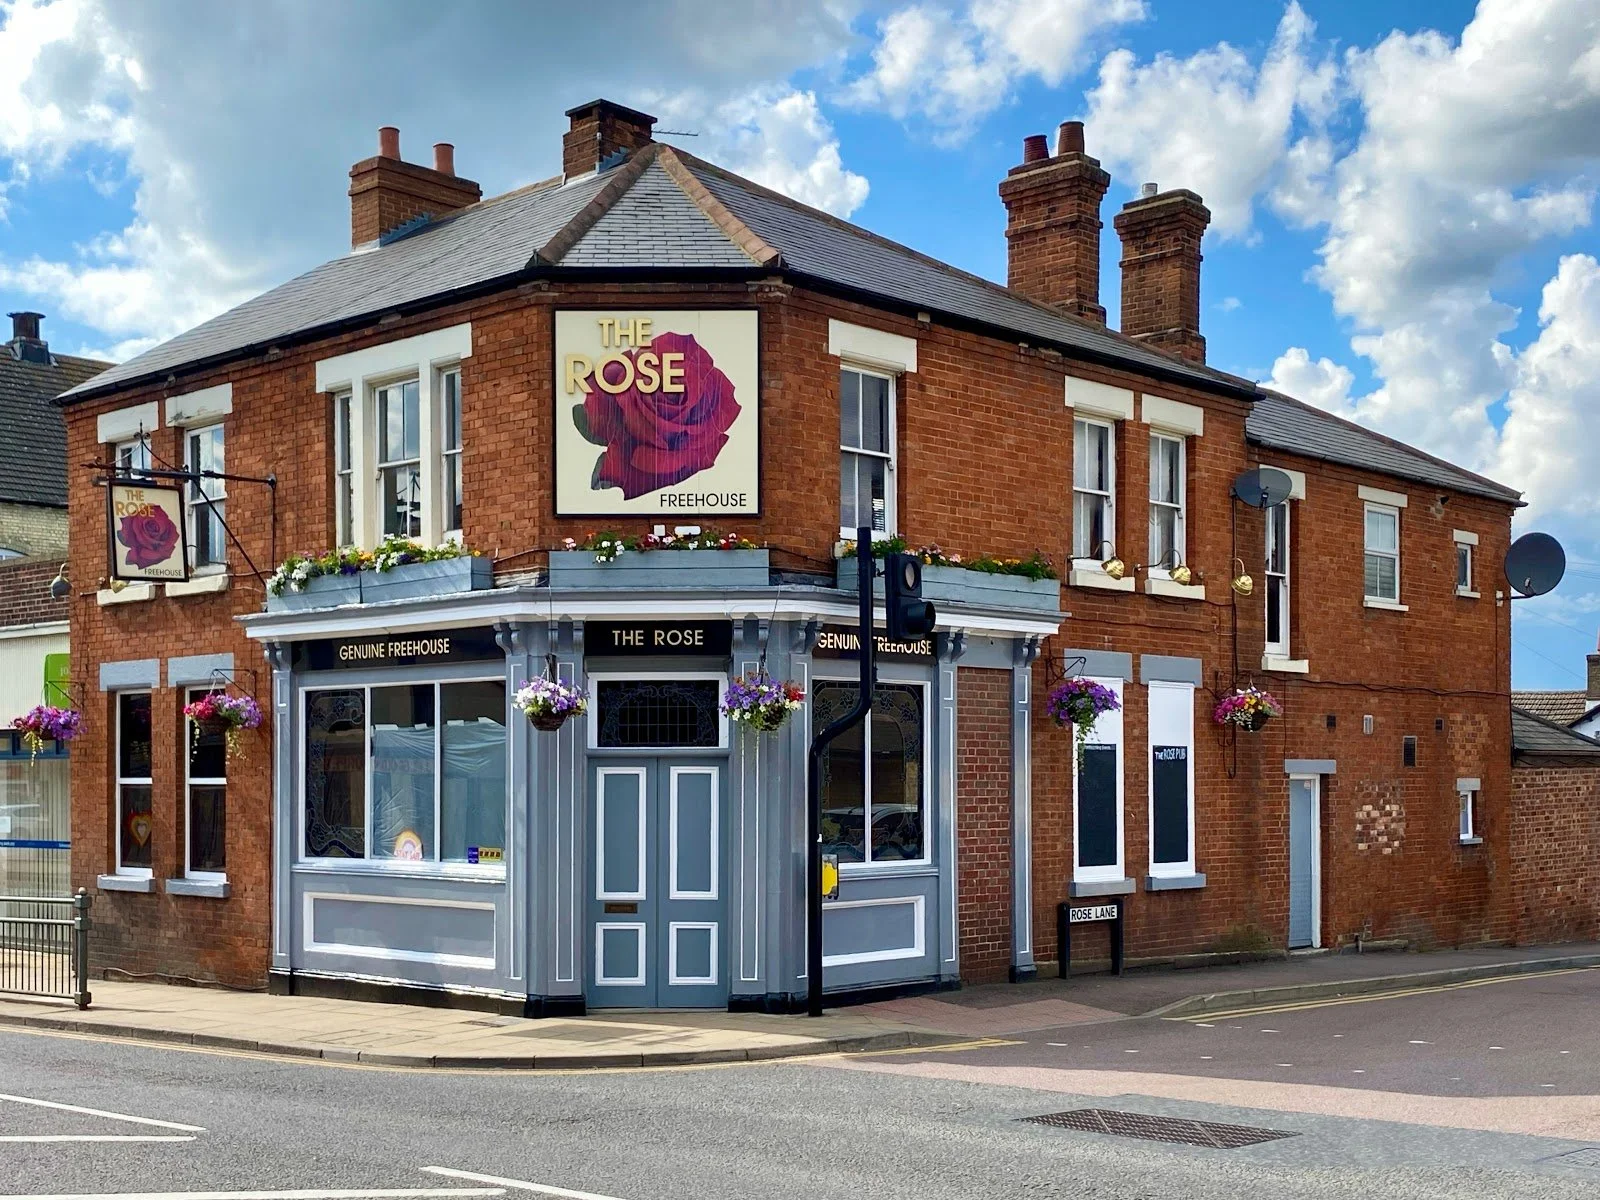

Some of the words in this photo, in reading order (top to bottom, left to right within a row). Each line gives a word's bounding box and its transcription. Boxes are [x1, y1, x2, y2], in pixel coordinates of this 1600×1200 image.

[598, 318, 653, 348] THE
[564, 352, 685, 394] ROSE
[125, 489, 145, 501] THE
[660, 493, 747, 507] FREEHOUSE
[115, 501, 155, 517] ROSE
[144, 568, 182, 577] FREEHOUSE
[612, 629, 644, 646] THE
[654, 629, 704, 646] ROSE
[817, 632, 861, 651] GENUIN
[339, 643, 385, 661] GENUINE
[388, 638, 450, 657] FREEHOUSE
[1071, 908, 1092, 920] ROSE
[1095, 906, 1116, 918] LANE
